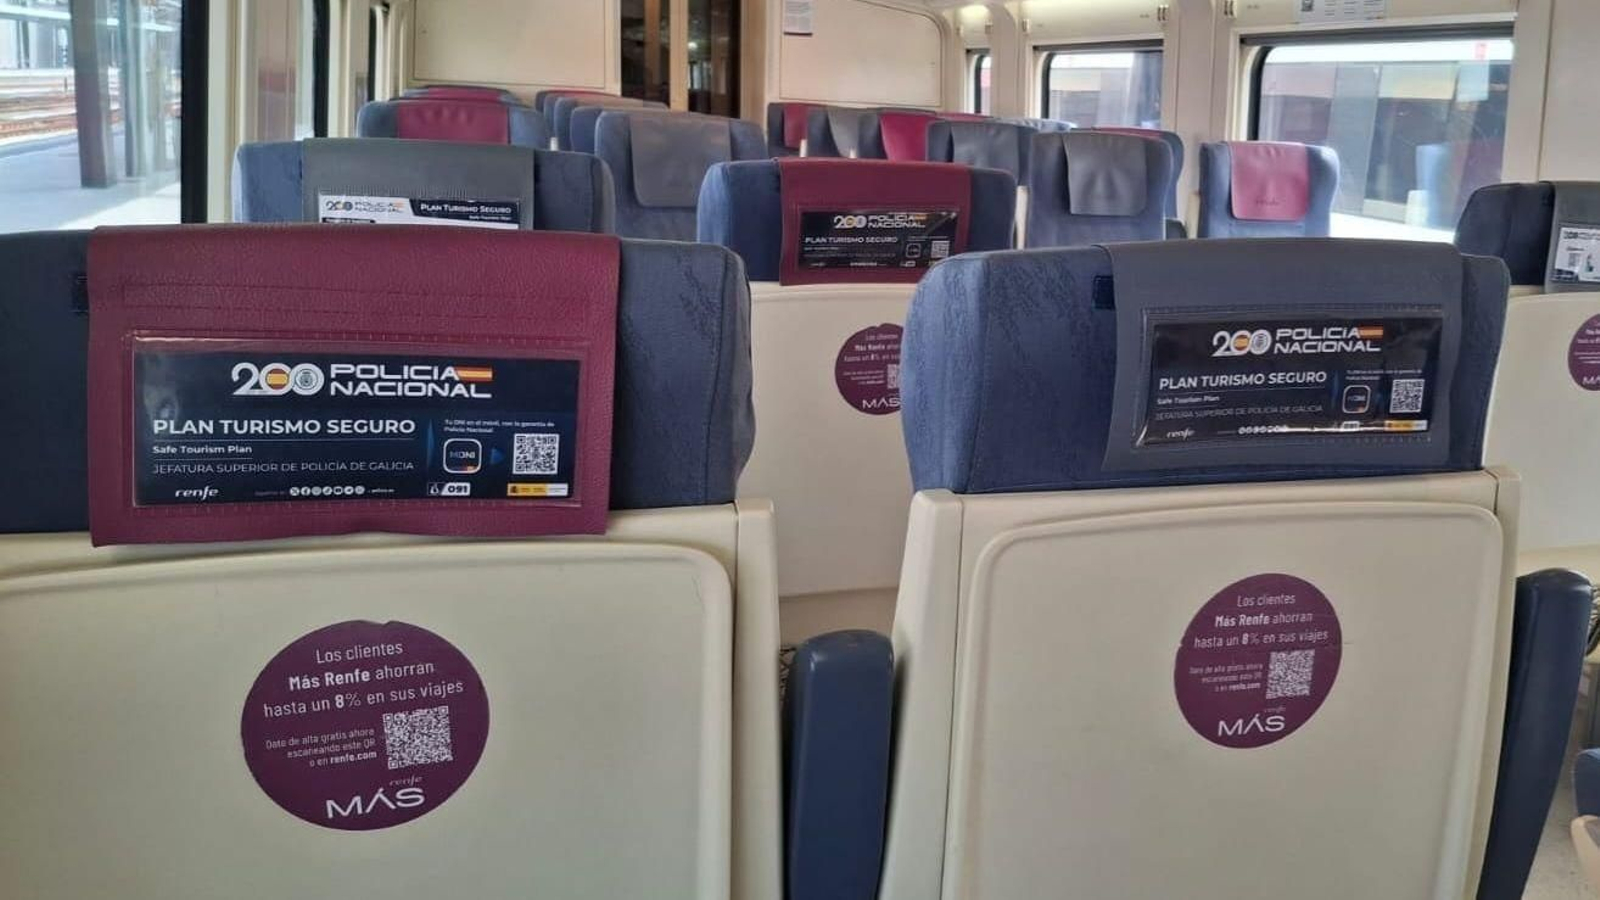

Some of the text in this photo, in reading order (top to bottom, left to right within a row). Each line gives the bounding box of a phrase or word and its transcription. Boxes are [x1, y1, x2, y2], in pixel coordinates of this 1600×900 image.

[1211, 330, 1272, 357] 200
[1273, 340, 1381, 355] NACIONAL
[231, 361, 326, 397] 200
[1159, 371, 1327, 390] PLAN TURISMO SEGURO
[330, 380, 493, 399] NACIONAL
[153, 418, 415, 436] PLAN TURISMO SEGURO
[153, 444, 253, 455] Safe Tourism Plan
[153, 463, 215, 475] JEFATURA
[216, 462, 279, 473] SUPERIOR
[281, 462, 298, 472] DE
[350, 461, 367, 471] DE
[369, 461, 415, 471] GALICIA
[175, 485, 219, 500] renfe
[447, 484, 468, 494] 091
[1237, 593, 1296, 608] Los clientes
[1238, 613, 1269, 627] Renfe
[1272, 612, 1314, 624] ahorran
[1193, 636, 1223, 649] hasta
[1225, 638, 1239, 647] un
[1262, 634, 1276, 644] en
[1278, 632, 1296, 643] sus
[1299, 628, 1329, 644] viajes
[316, 642, 404, 664] Los clientes
[288, 661, 435, 692] Más Renfe ahorran
[263, 679, 464, 718] hasta un 8% en sus viajes
[1218, 713, 1286, 737] MÁS
[302, 735, 319, 746] alta
[320, 731, 347, 744] gratis
[317, 757, 328, 767] en
[330, 751, 377, 764] renfe.com
[325, 787, 425, 819] MÁS
